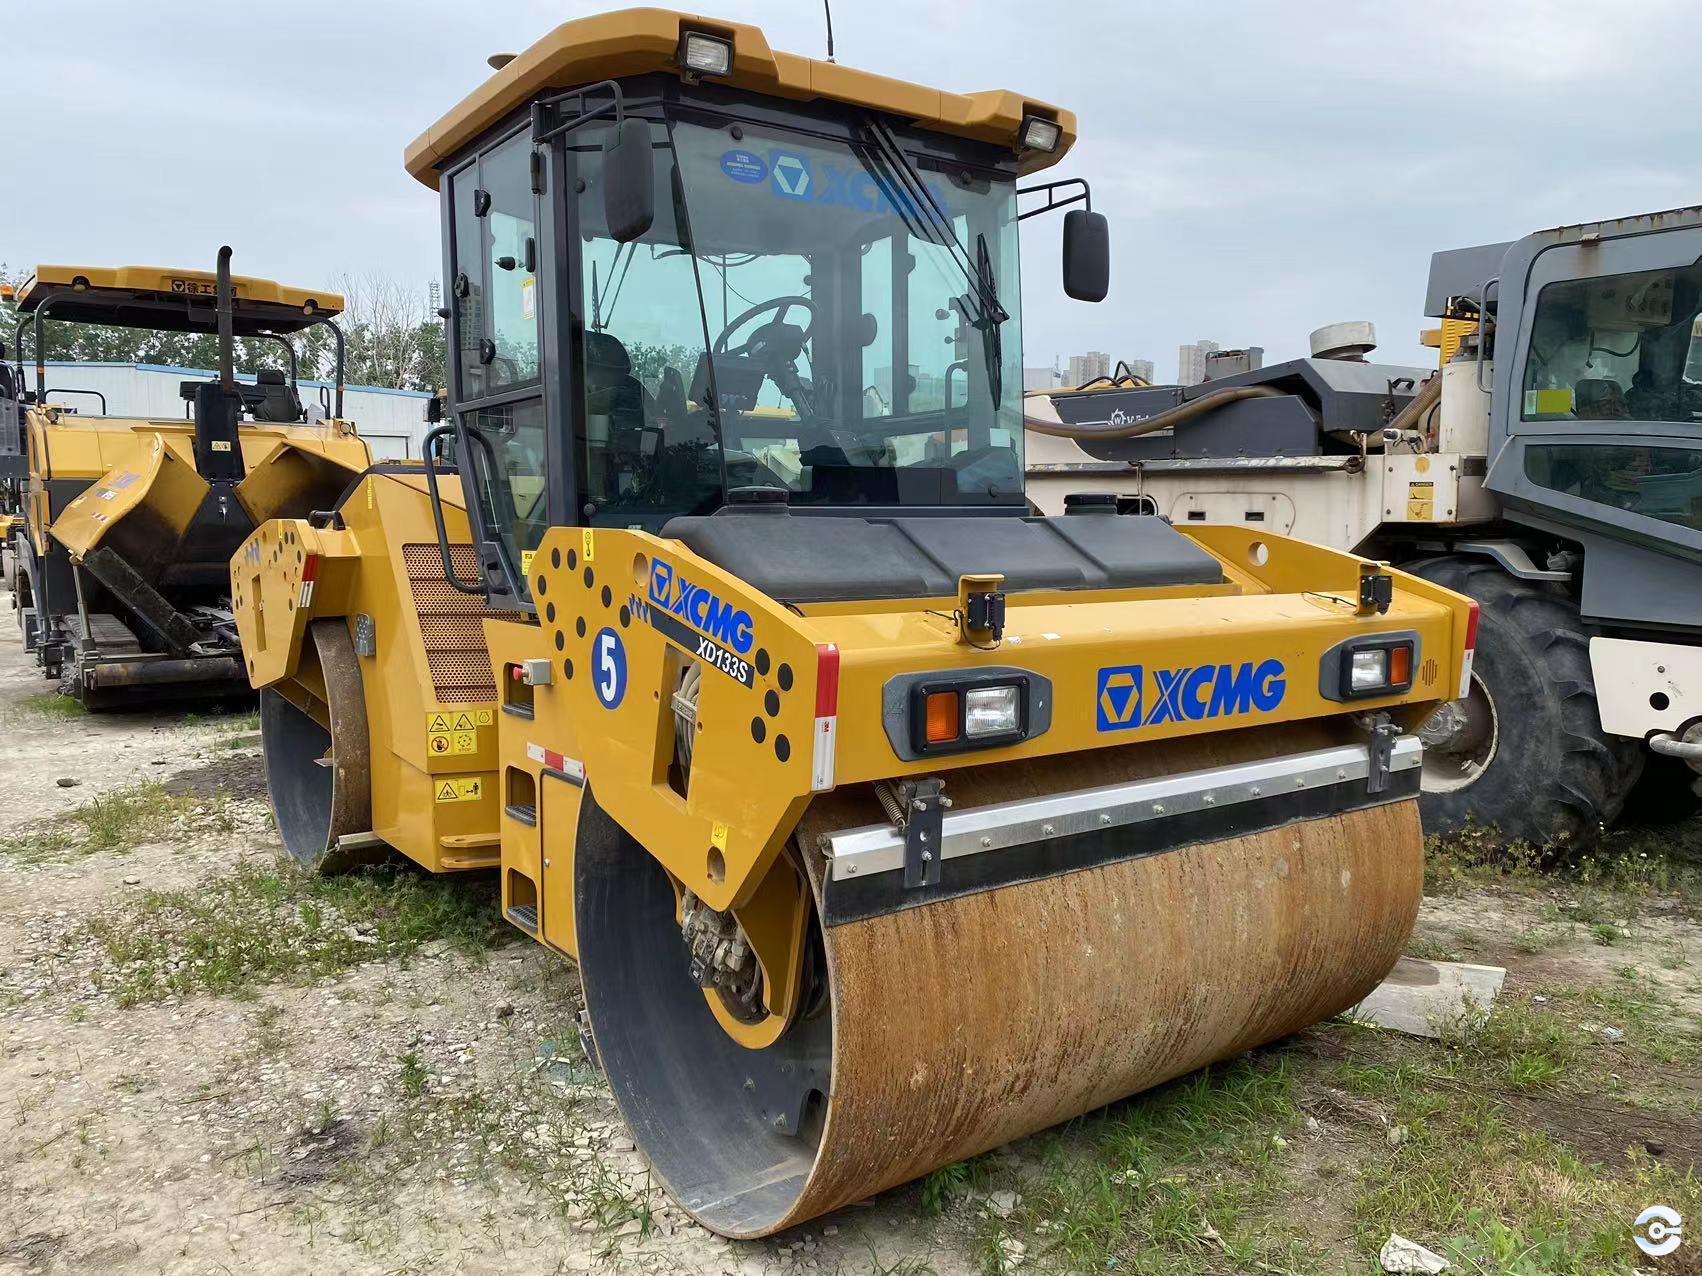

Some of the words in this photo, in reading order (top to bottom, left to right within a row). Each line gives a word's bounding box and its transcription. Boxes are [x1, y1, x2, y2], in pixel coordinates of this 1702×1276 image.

[669, 578, 754, 654] XCMG
[601, 634, 617, 702] 5
[695, 635, 749, 684] XD133S
[1143, 658, 1287, 725] XCMG
